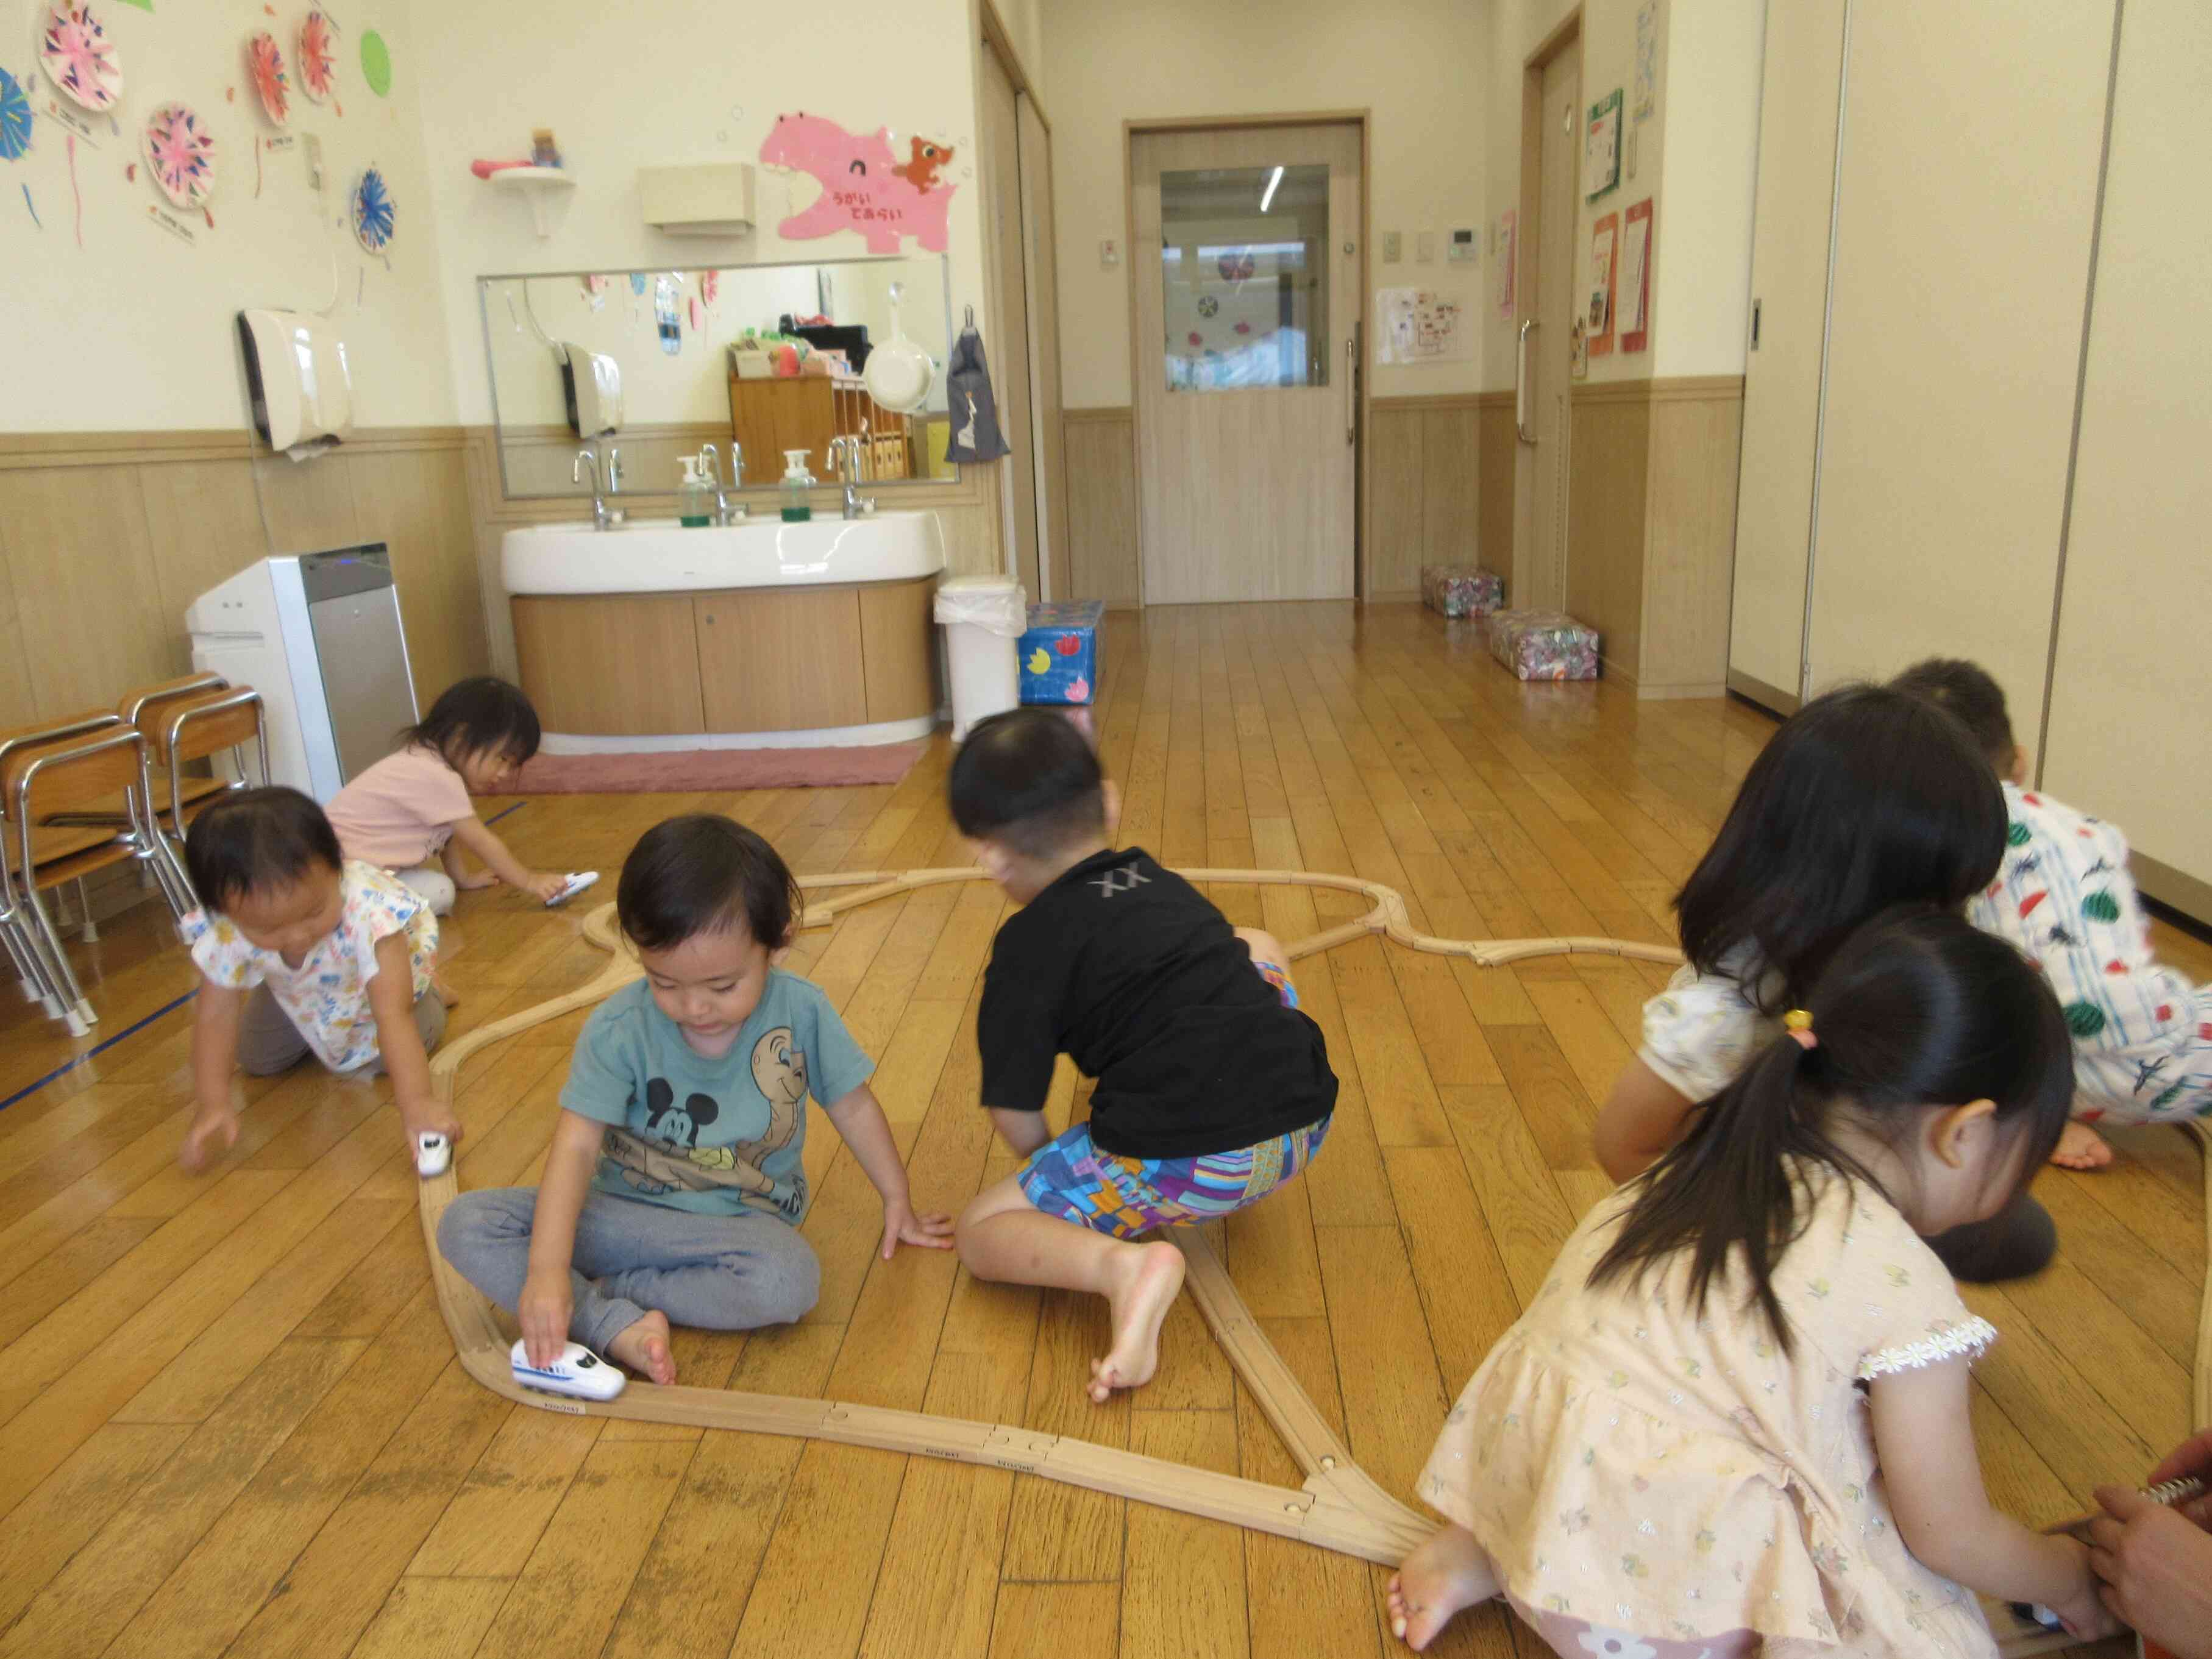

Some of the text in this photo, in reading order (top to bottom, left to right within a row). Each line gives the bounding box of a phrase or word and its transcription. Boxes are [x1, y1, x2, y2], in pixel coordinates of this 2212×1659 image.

[832, 191, 870, 205] うがい
[852, 207, 902, 221] てあらい
